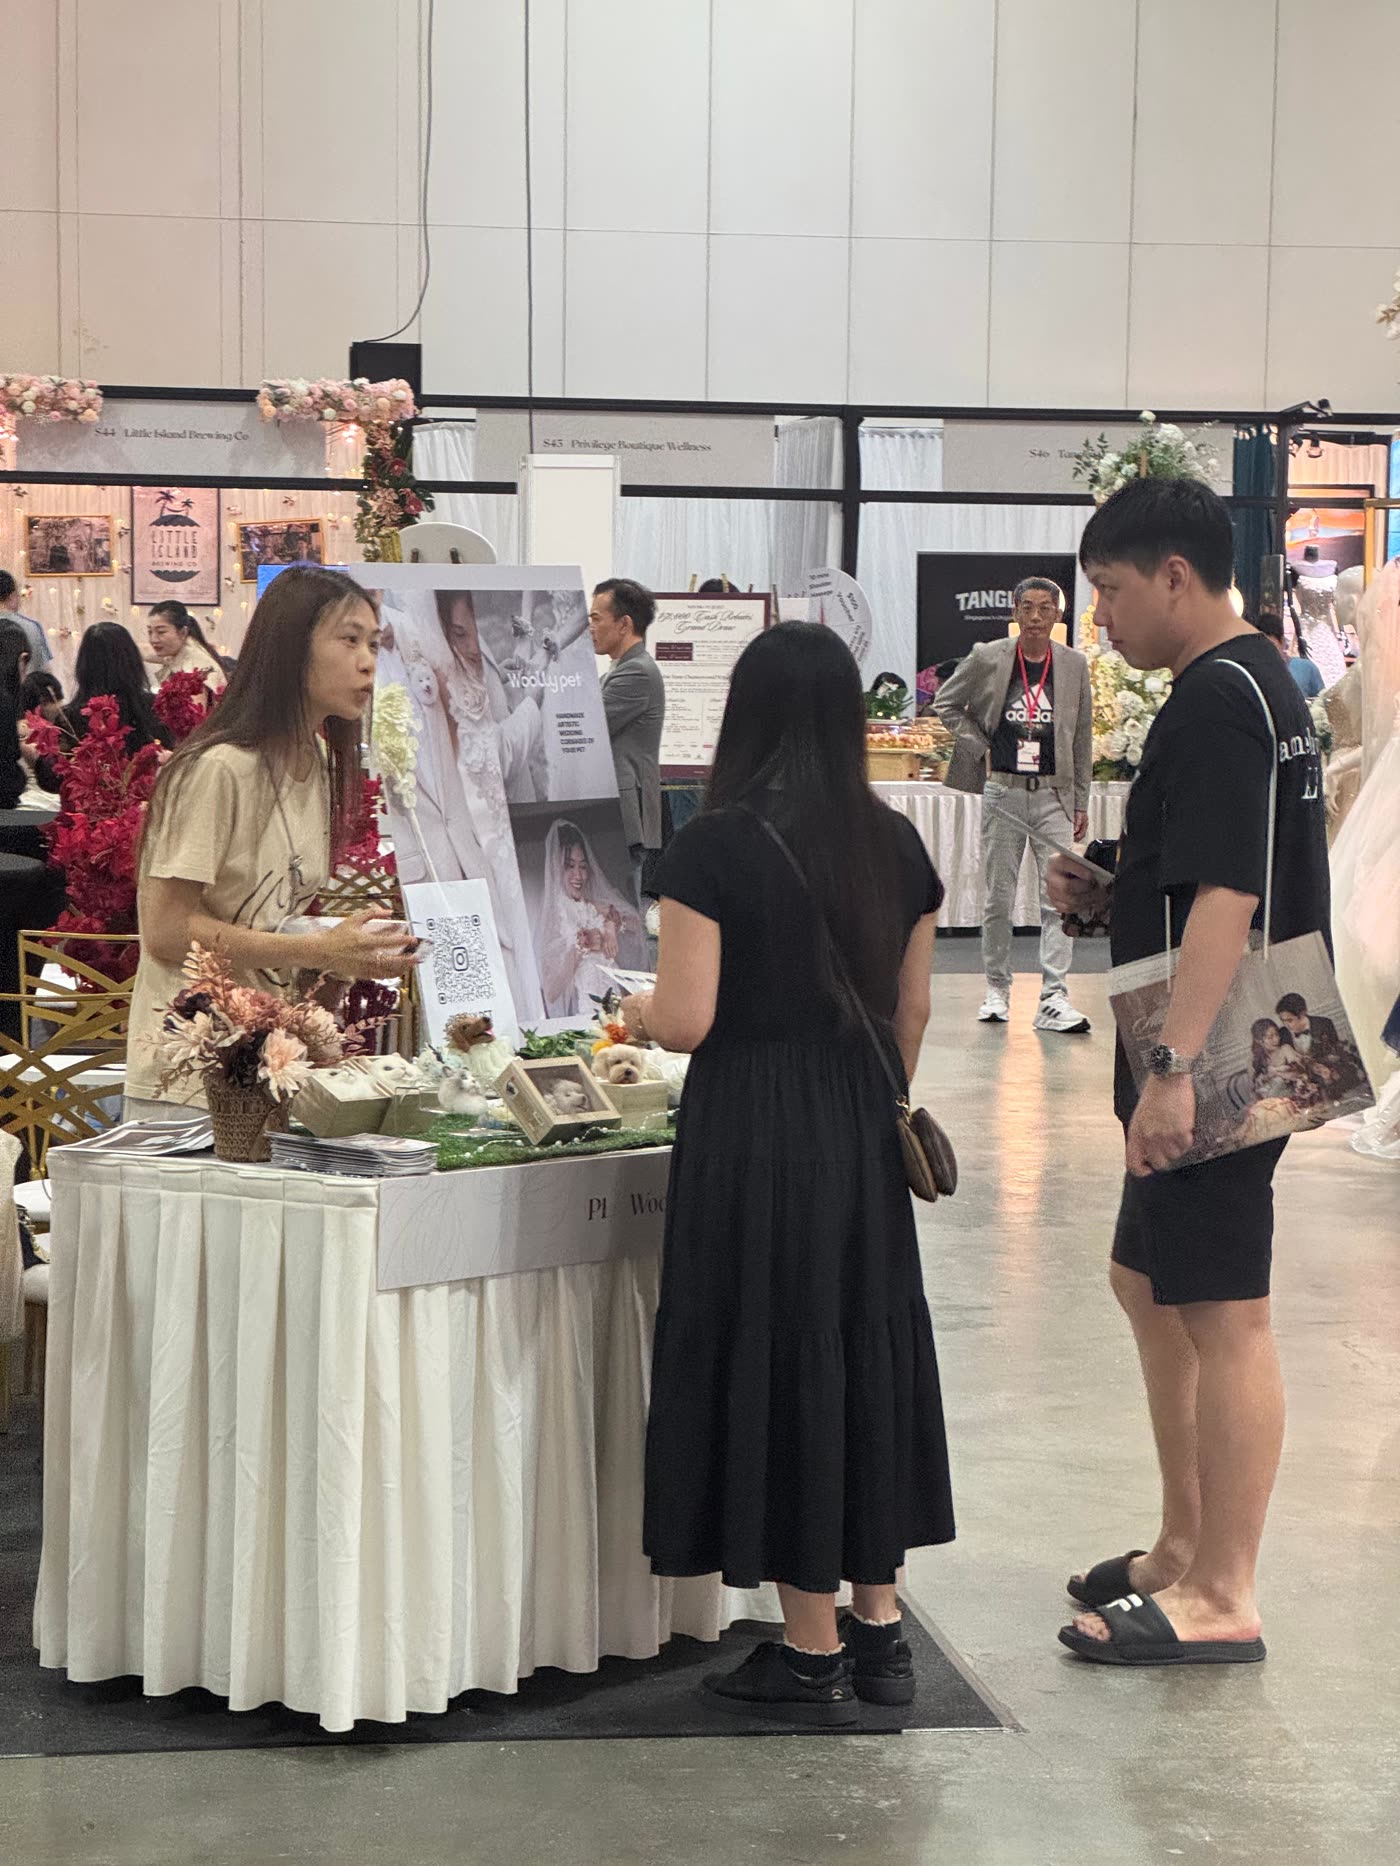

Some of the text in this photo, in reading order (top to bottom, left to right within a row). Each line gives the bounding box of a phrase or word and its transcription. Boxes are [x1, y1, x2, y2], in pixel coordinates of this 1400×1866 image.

[95, 428, 249, 442] S44 Little Island Brewing Co
[543, 439, 712, 451] S45 Privilege Boutique Wellness
[151, 530, 198, 544] LITTLE
[151, 545, 198, 558] ISLAND
[955, 590, 1015, 611] TANGL
[1005, 708, 1052, 723] adda
[630, 1193, 666, 1216] Woo
